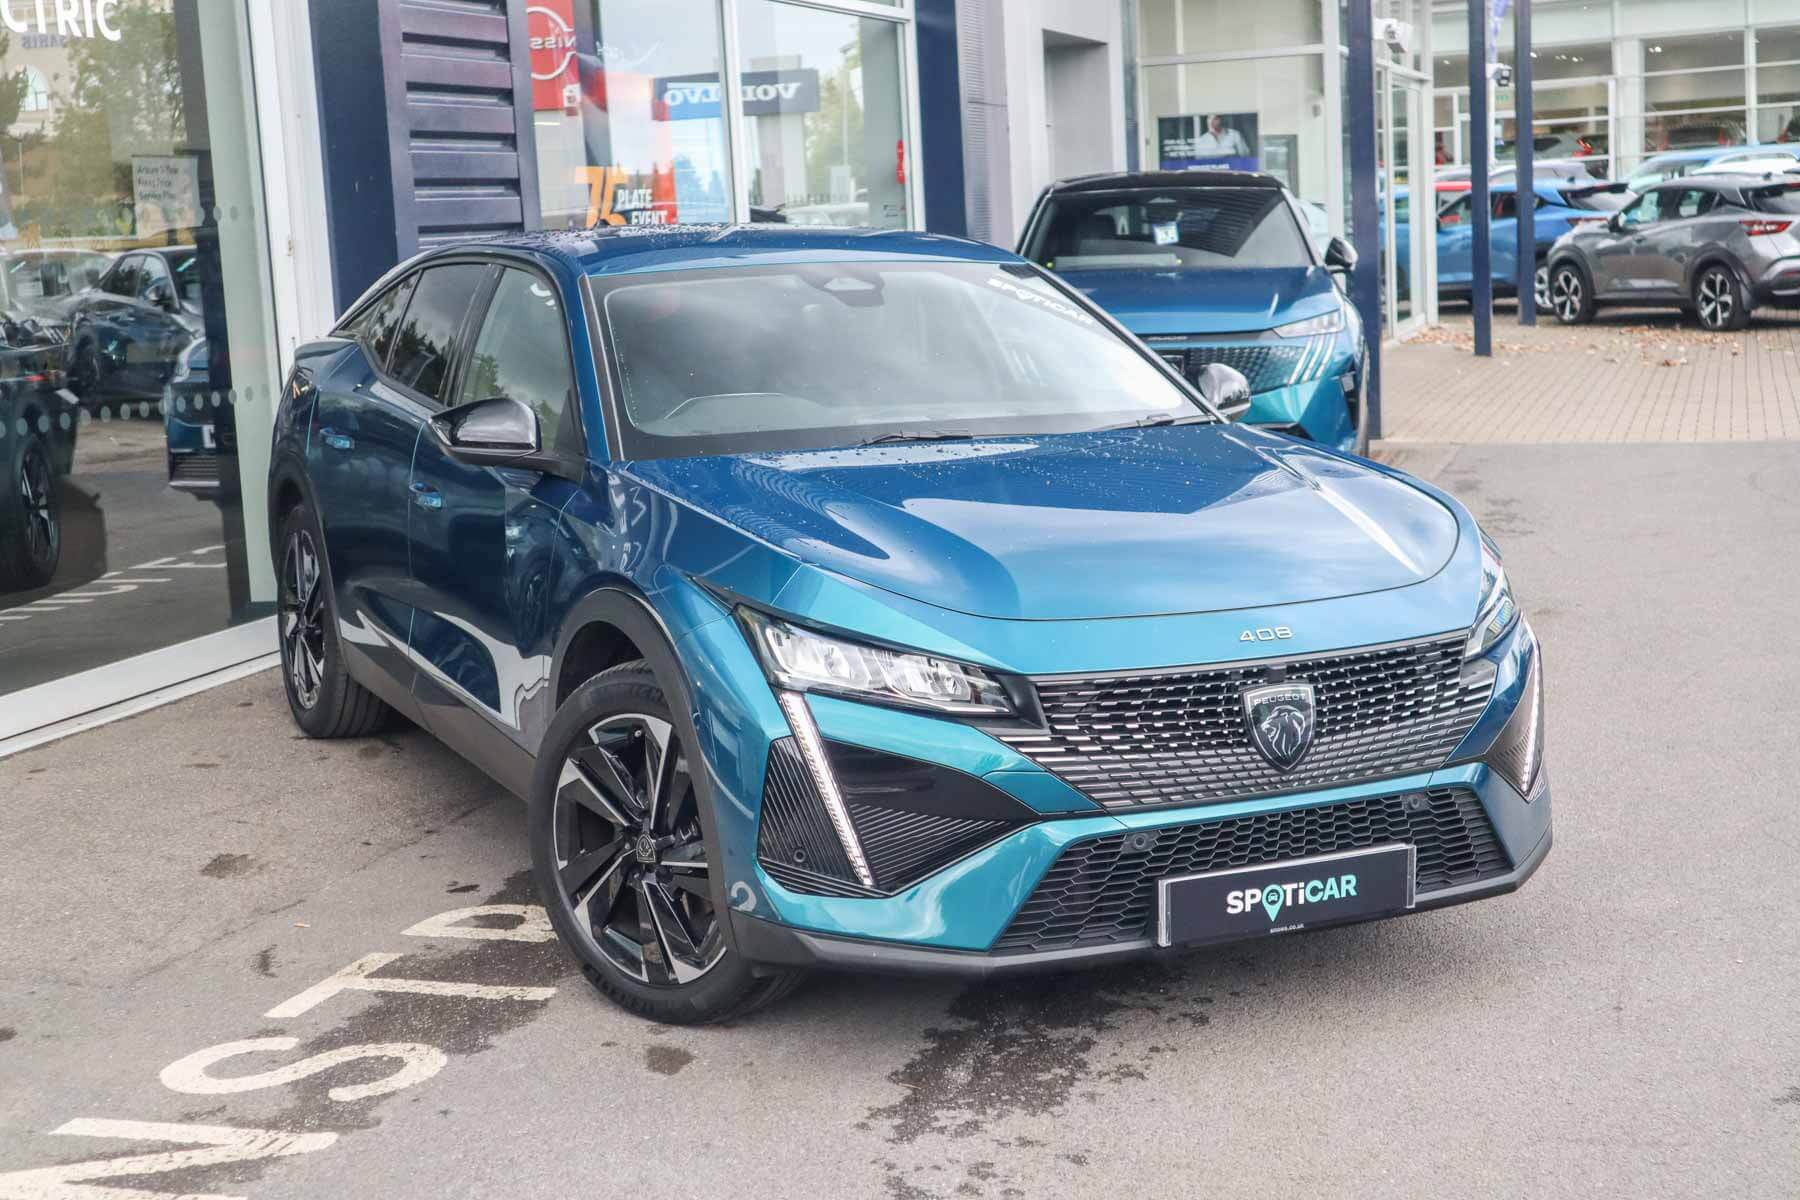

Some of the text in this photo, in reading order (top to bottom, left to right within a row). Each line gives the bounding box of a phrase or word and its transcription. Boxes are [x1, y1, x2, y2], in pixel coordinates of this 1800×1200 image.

[616, 187, 653, 210] PLATE
[631, 209, 669, 225] EVENT
[1240, 626, 1293, 642] 408
[1254, 693, 1306, 705] PEUGEOT
